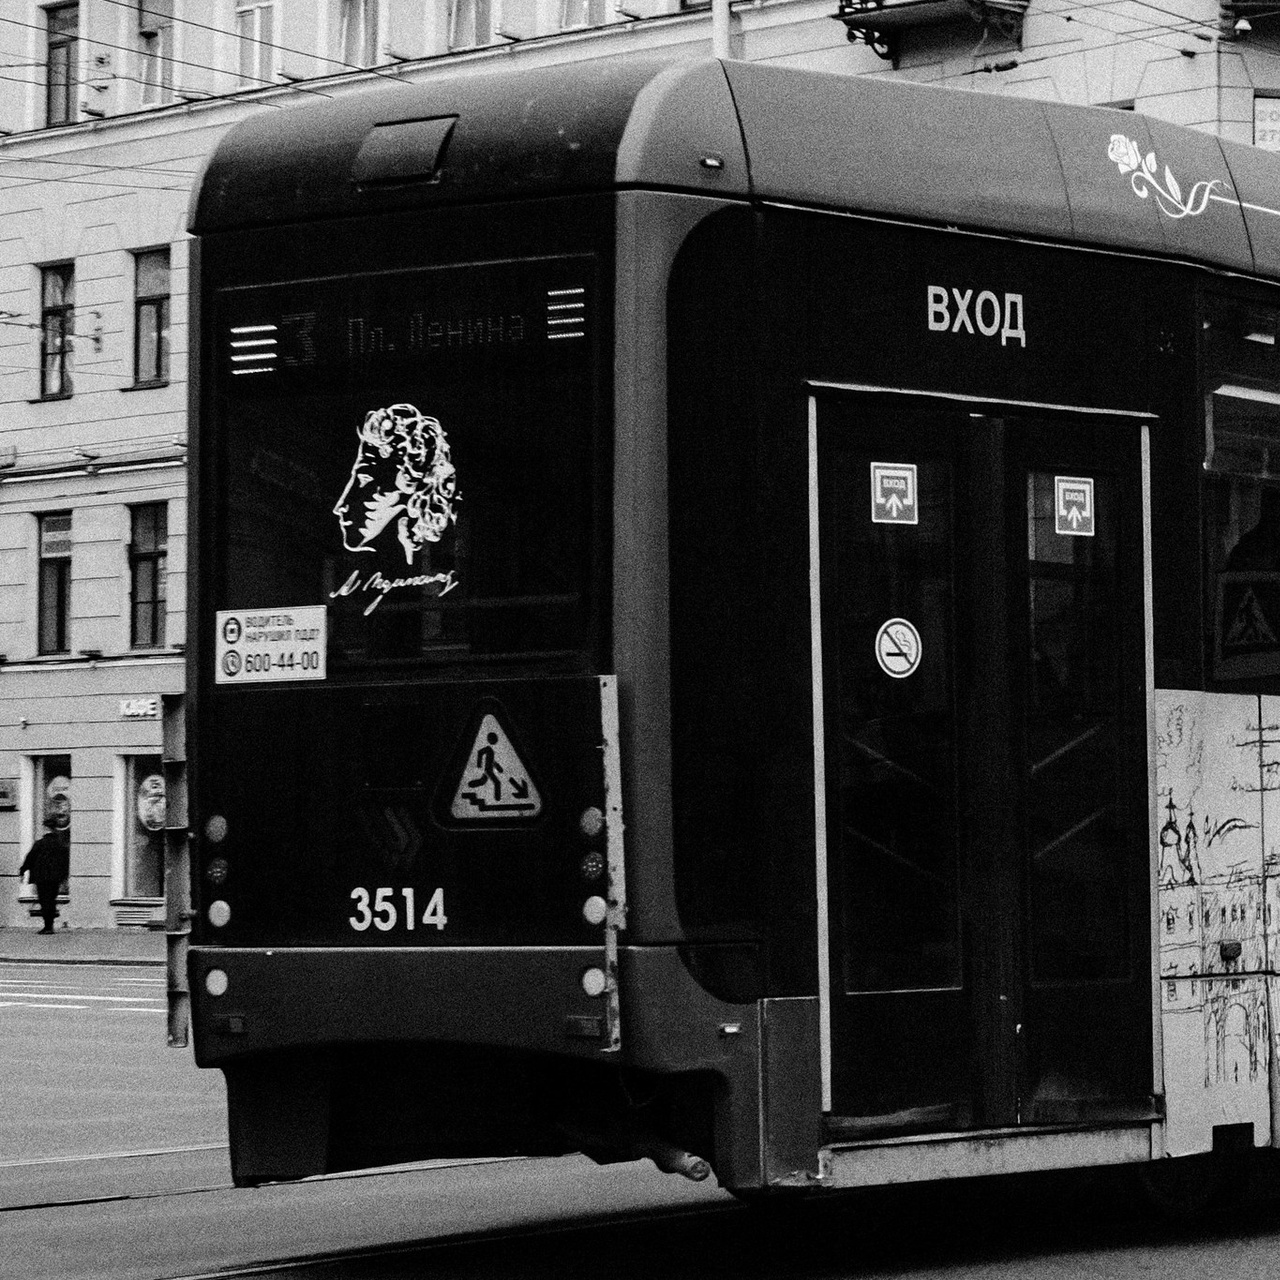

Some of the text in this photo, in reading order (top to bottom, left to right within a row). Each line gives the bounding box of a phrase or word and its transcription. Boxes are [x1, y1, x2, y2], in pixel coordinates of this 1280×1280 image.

[927, 284, 1027, 348] ВХОД
[281, 312, 525, 366] 3 Пл. Ленина
[245, 614, 295, 628] ВОДИТЕЛЬ
[245, 629, 292, 643] НАРУШИЛ
[245, 650, 320, 674] 600-44-00
[349, 886, 448, 932] 3514
